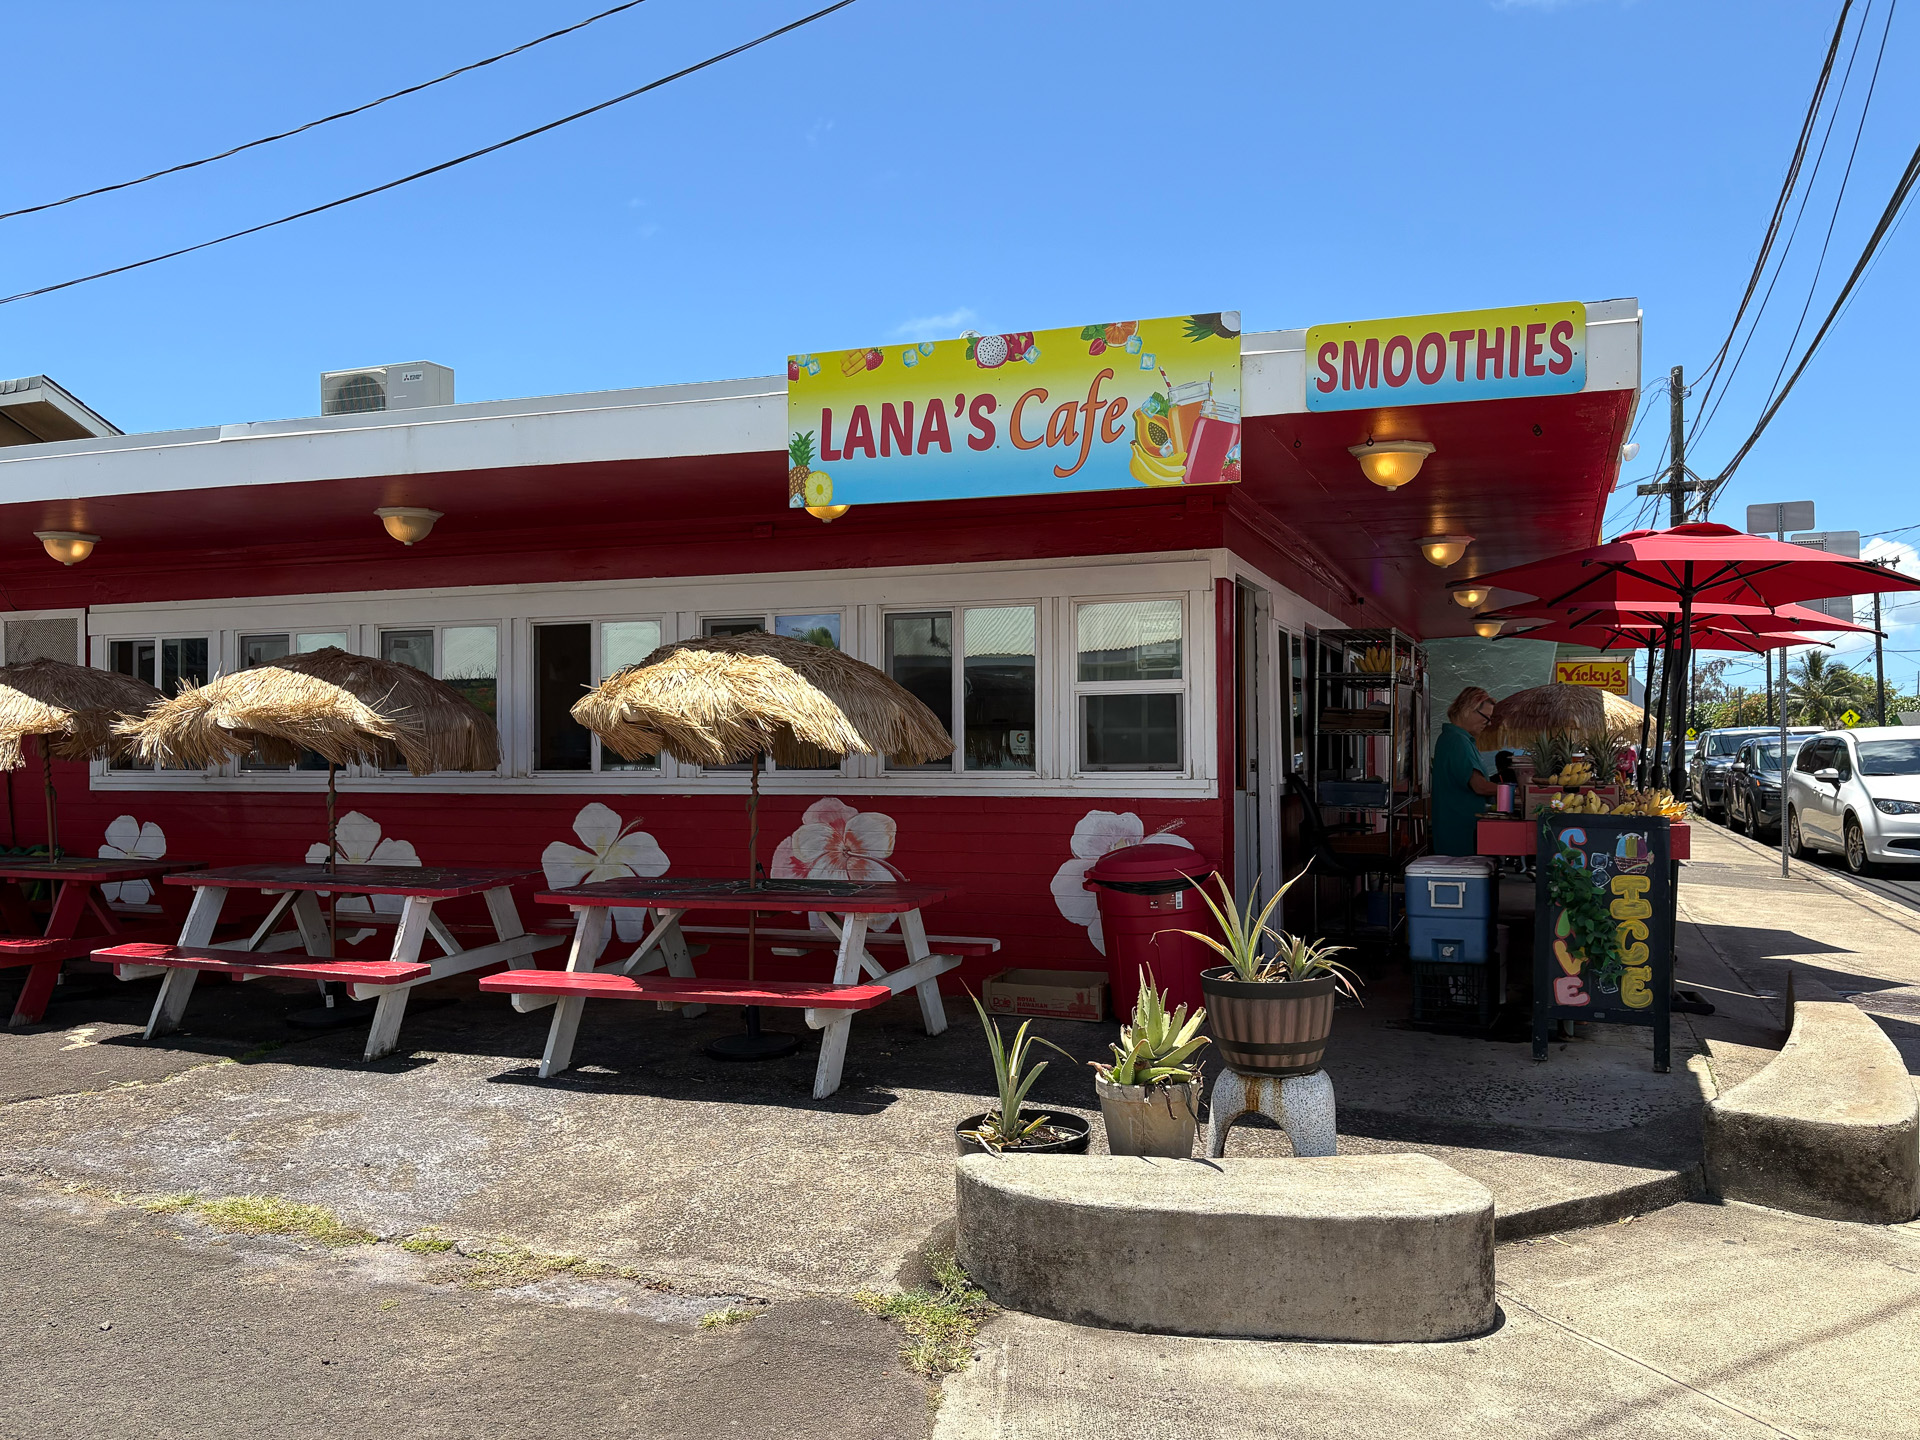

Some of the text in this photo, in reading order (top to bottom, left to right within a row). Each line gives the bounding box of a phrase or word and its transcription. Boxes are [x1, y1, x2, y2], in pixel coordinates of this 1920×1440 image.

[1316, 320, 1574, 393] SMOOTHIES
[820, 367, 1129, 479] LANA'S Cafe
[1558, 664, 1626, 687] Vicky's
[1610, 875, 1653, 1008] ICE
[993, 997, 1011, 1007] Dole
